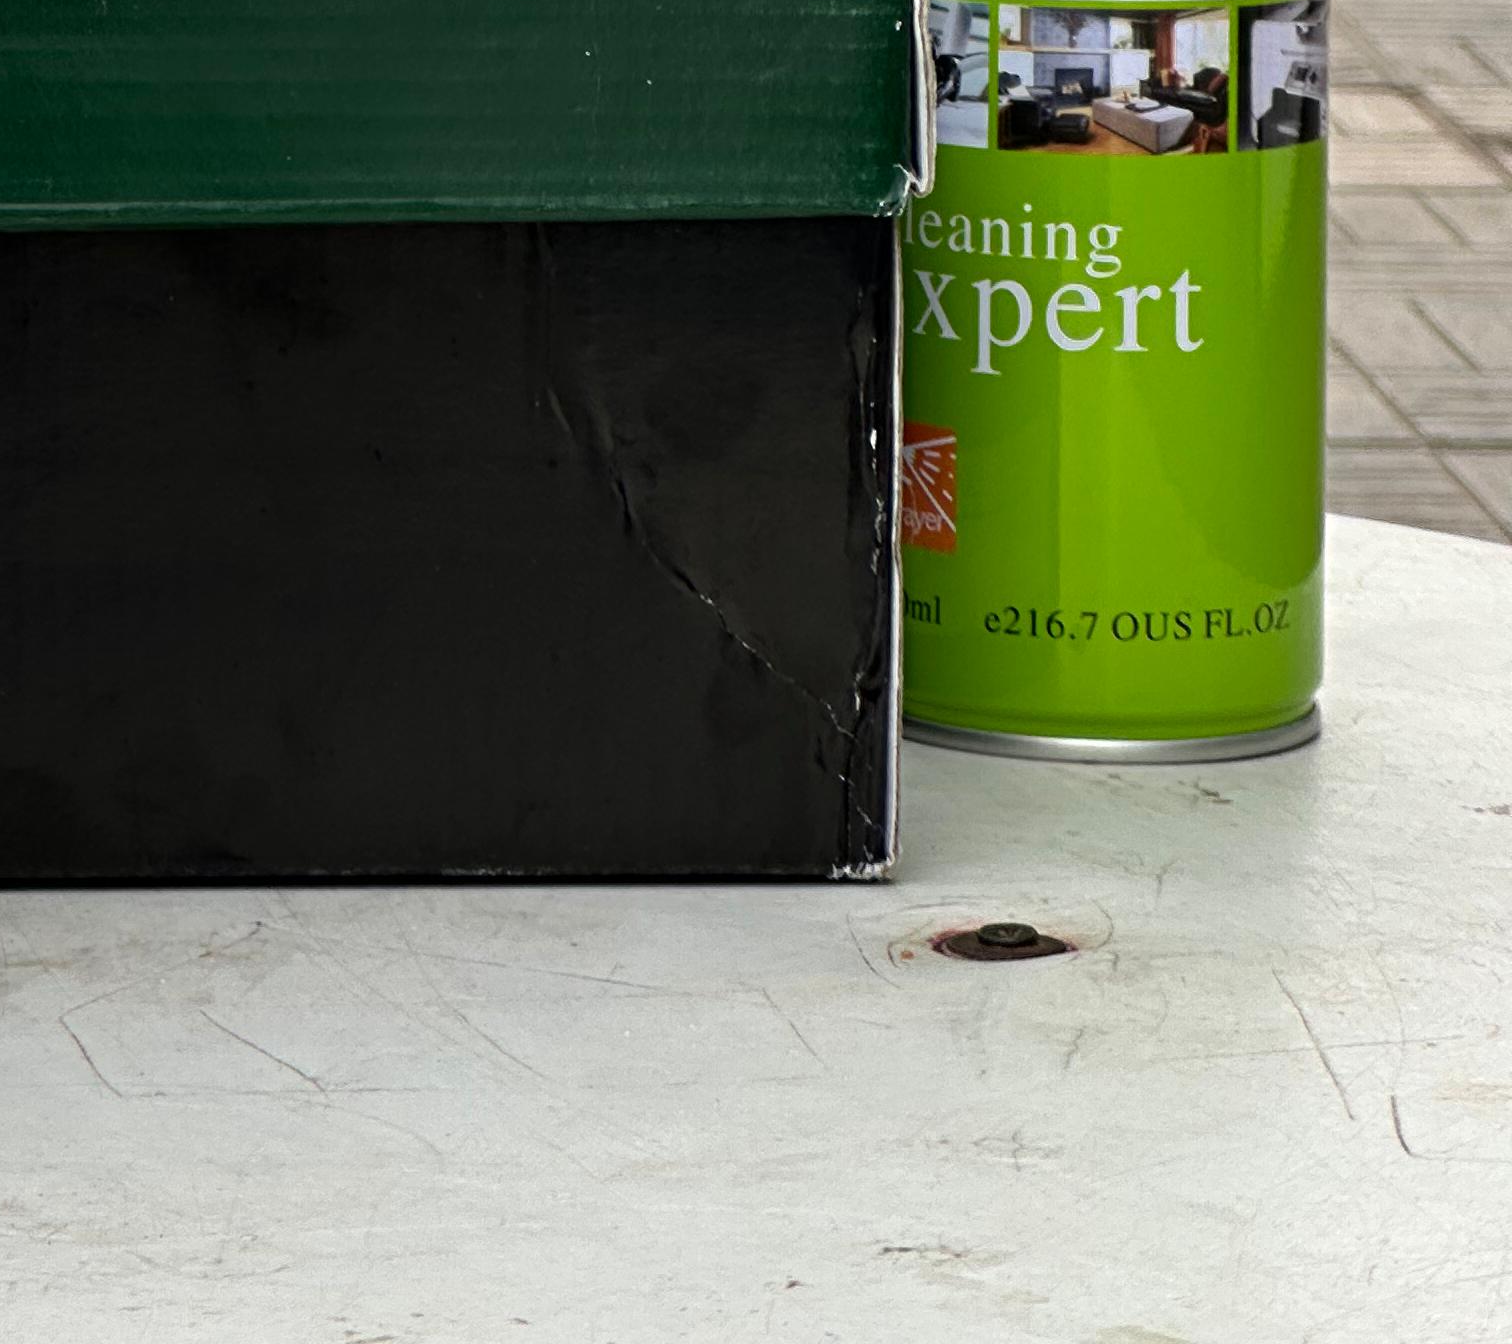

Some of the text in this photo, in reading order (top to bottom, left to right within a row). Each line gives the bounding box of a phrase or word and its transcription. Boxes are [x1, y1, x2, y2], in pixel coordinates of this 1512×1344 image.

[904, 195, 1124, 279] leaning
[911, 268, 1205, 376] xpert
[904, 590, 942, 625] ml
